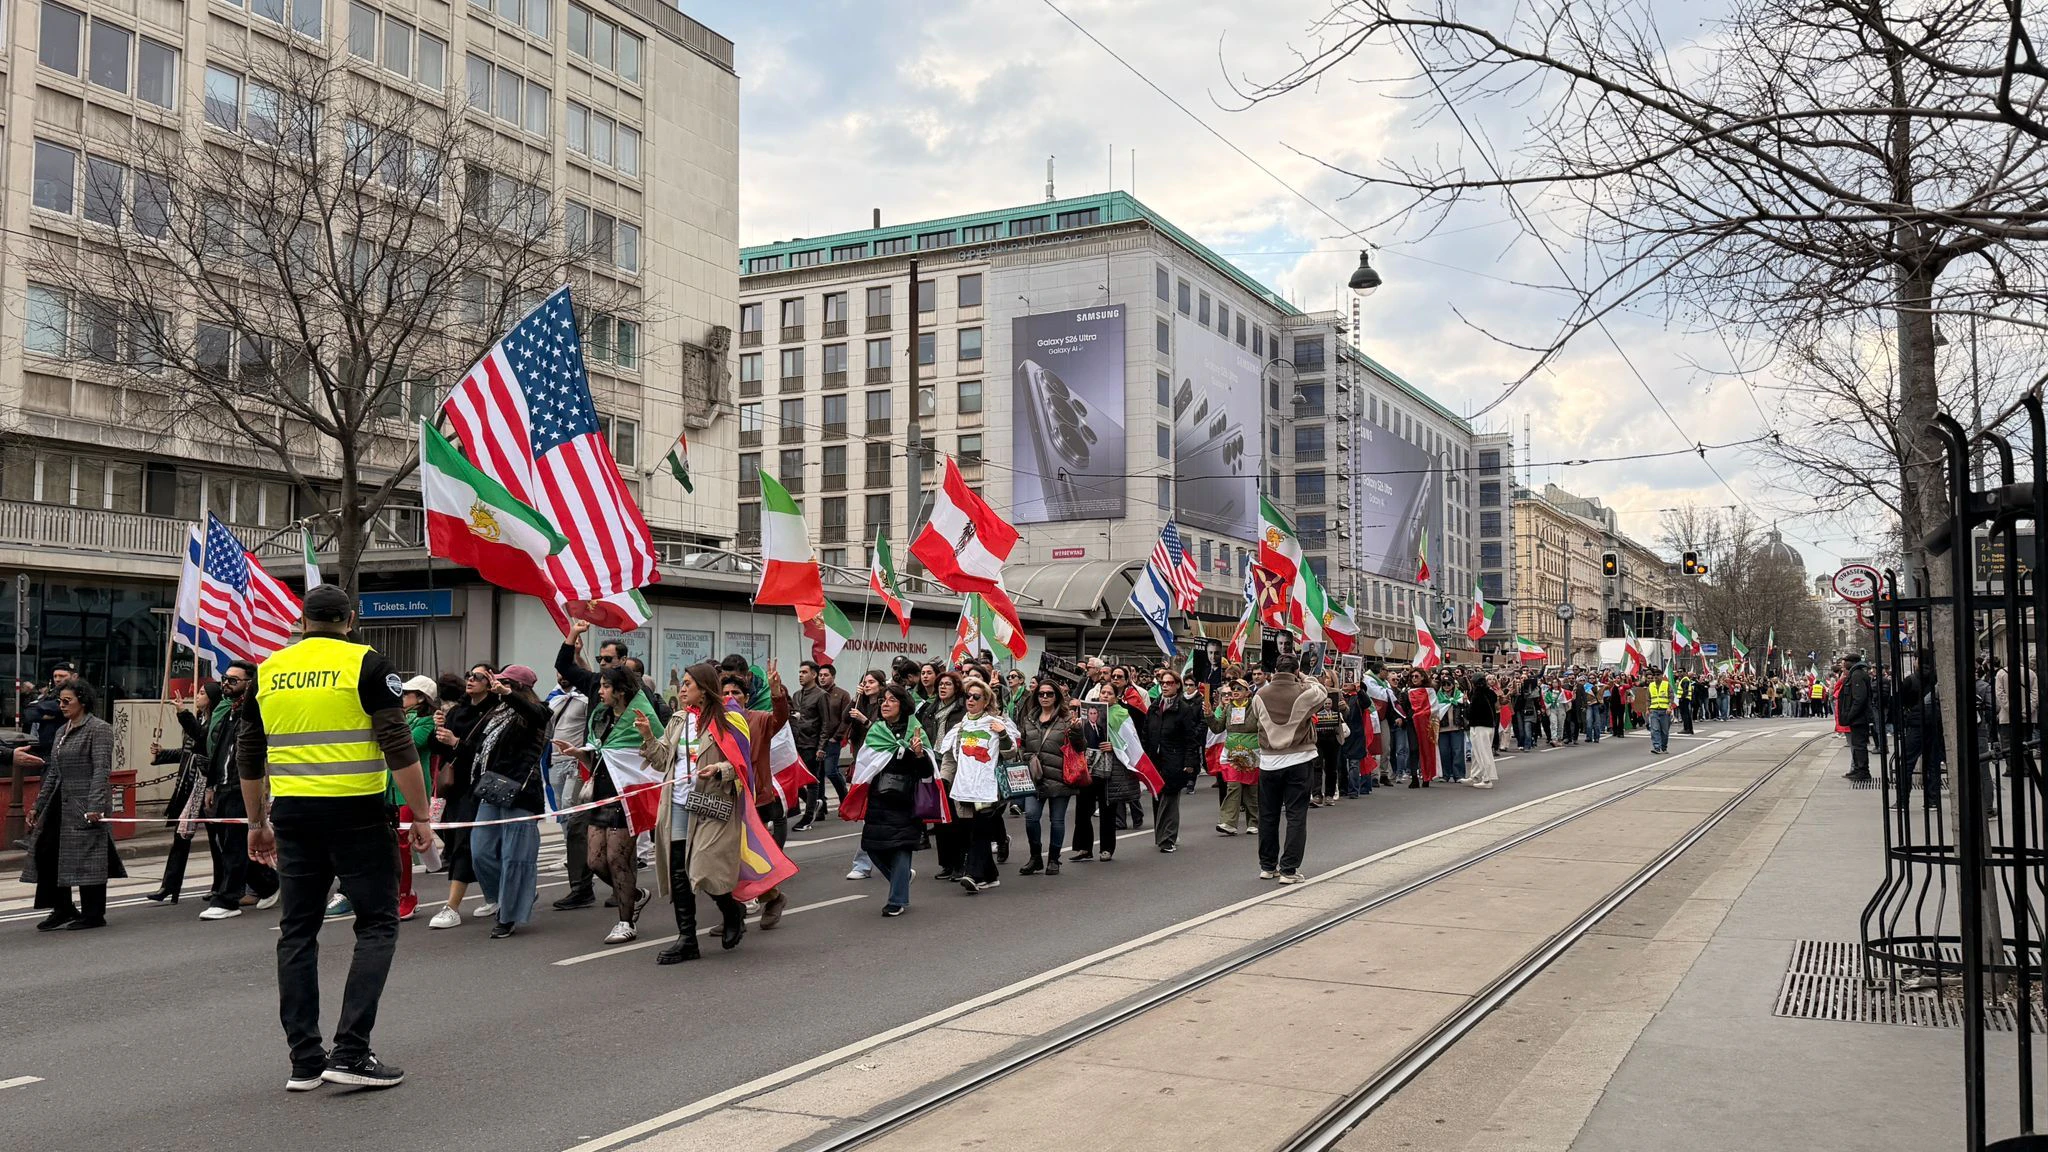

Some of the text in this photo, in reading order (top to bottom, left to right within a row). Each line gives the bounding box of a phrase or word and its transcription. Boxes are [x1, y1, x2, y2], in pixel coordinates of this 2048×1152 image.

[1076, 309, 1119, 323] SAMSUNG
[1037, 333, 1097, 347] Galaxy S26 Ultra
[1048, 346, 1071, 355] Galaxy
[1841, 587, 1873, 596] HALTESTELL
[373, 601, 429, 612] Tickets. Info.
[675, 641, 700, 649] SOMMER
[869, 638, 907, 654] KÄRNTNER
[909, 643, 928, 654] RING
[271, 670, 341, 691] SECURITY
